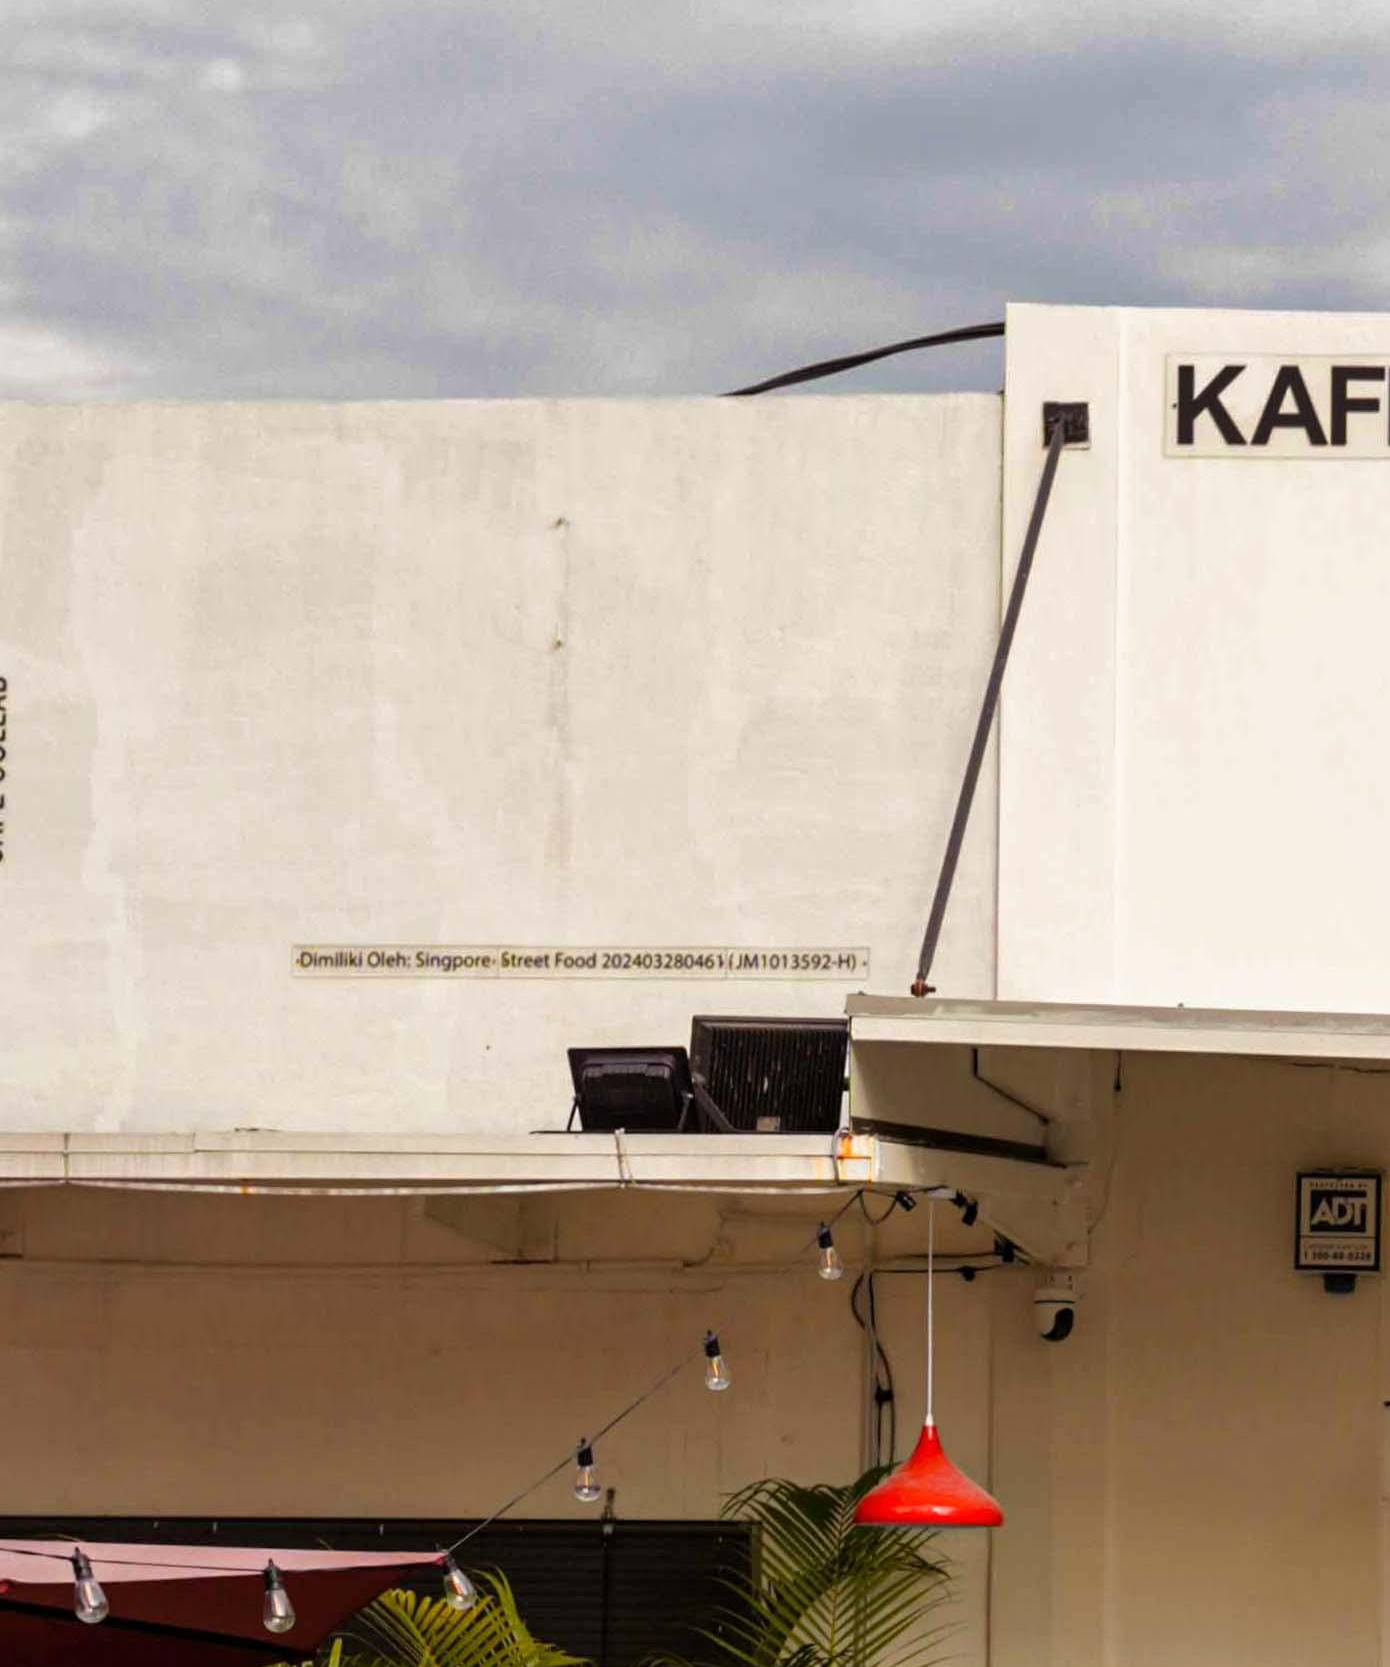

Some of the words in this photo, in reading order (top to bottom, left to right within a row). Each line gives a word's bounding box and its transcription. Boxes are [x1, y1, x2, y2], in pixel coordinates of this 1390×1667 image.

[299, 950, 363, 969] Dimiliki
[366, 950, 411, 969] Oleh:
[415, 950, 492, 972] Singpore
[500, 951, 550, 969] Street
[554, 952, 597, 970] Food
[728, 954, 857, 972] (JM1013592-H)
[1310, 1195, 1368, 1226] ADT
